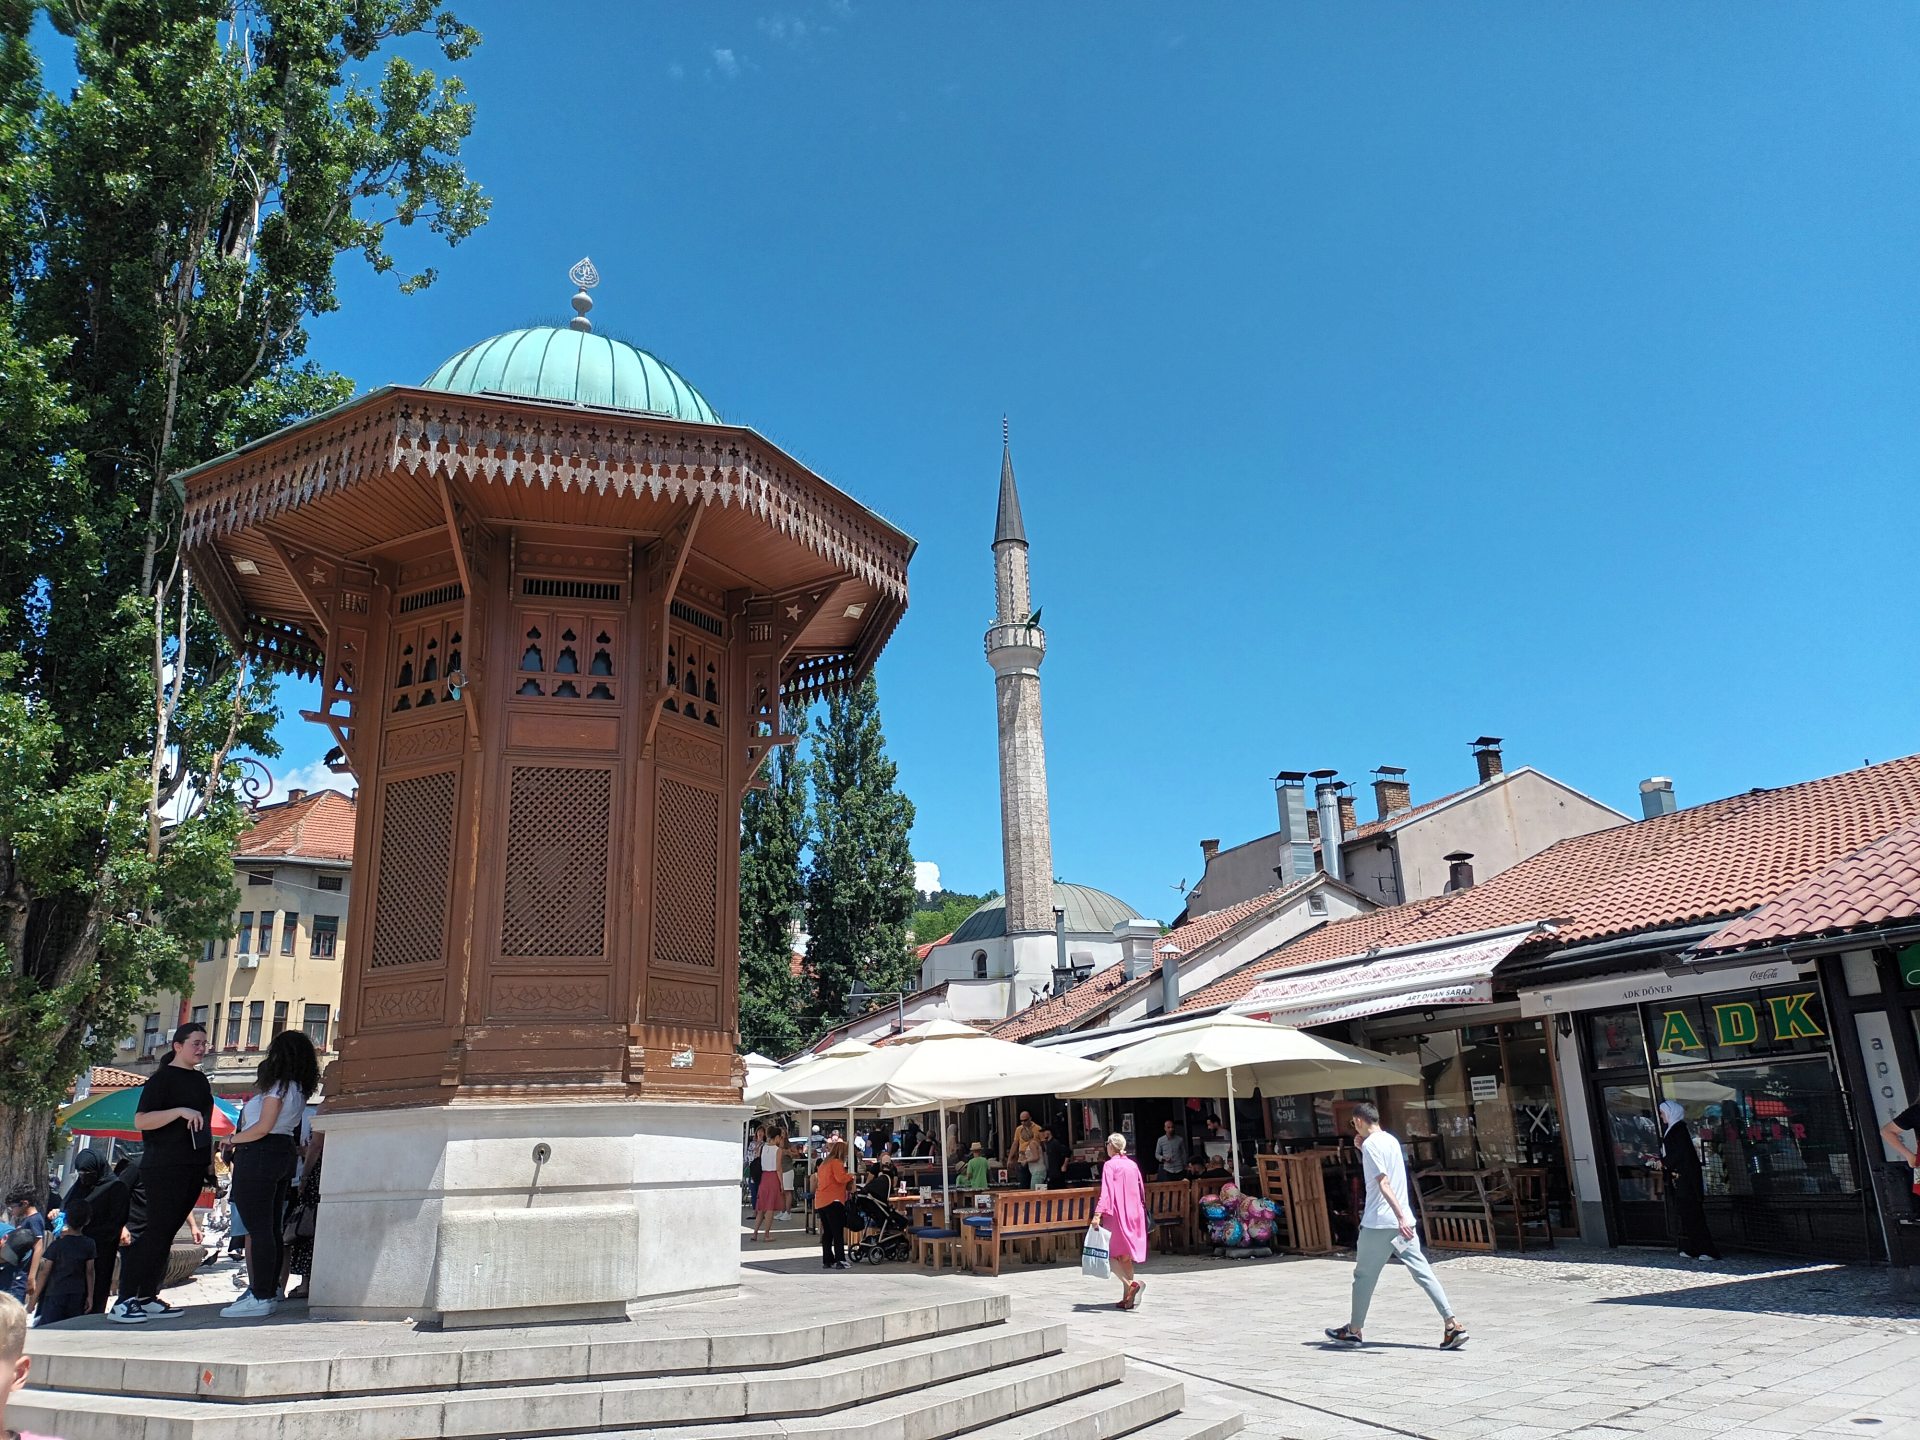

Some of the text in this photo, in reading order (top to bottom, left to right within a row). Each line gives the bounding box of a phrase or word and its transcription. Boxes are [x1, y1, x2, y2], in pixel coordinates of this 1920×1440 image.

[1421, 990, 1444, 1000] DIVAN
[1445, 987, 1473, 997] SARAJ
[1622, 984, 1673, 999] ADK DÖNER
[1658, 992, 1825, 1052] ADK
